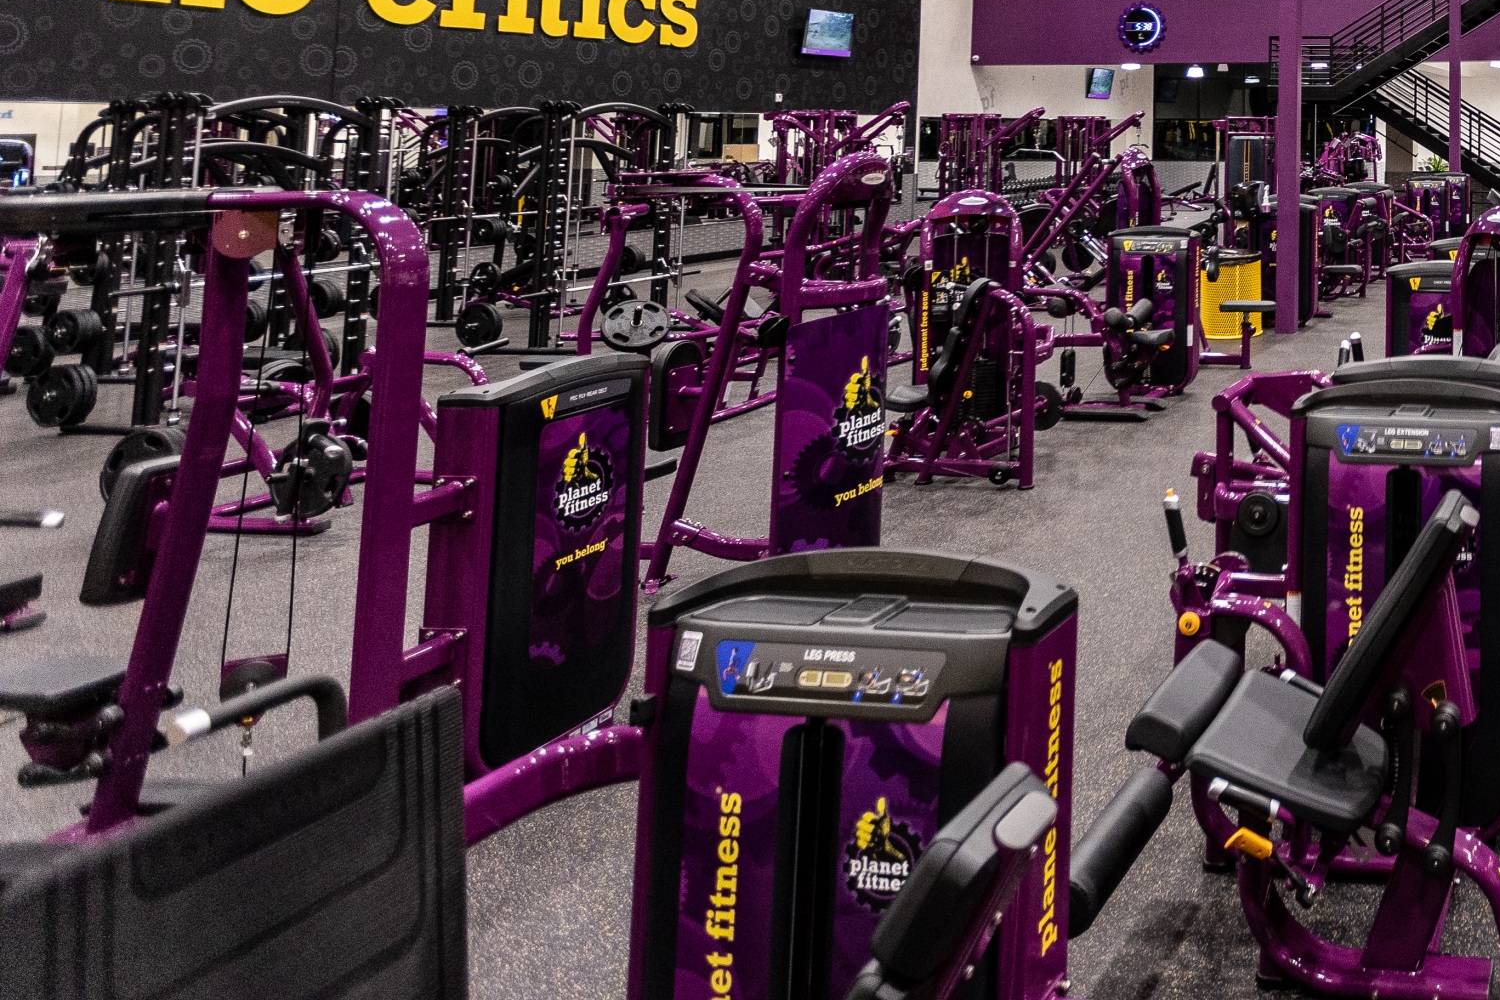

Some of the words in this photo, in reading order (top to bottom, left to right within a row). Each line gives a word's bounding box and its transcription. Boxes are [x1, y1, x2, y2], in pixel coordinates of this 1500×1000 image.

[920, 311, 929, 327] free
[920, 327, 929, 371] judgement
[838, 407, 881, 438] planet
[1384, 428, 1396, 436] LEG
[1396, 428, 1430, 437] EXTENSION
[558, 478, 601, 509] planet
[564, 491, 608, 516] fitness
[834, 490, 857, 507] you
[555, 553, 573, 570] you
[575, 539, 606, 560] belong
[1344, 506, 1364, 592] fitness
[1345, 596, 1363, 647] net
[804, 649, 823, 661] LEG
[823, 649, 856, 663] PRESS
[1043, 658, 1063, 799] itness
[705, 792, 742, 942] fitness
[850, 855, 909, 876] planet
[857, 871, 906, 891] fitne
[1038, 817, 1057, 958] plane
